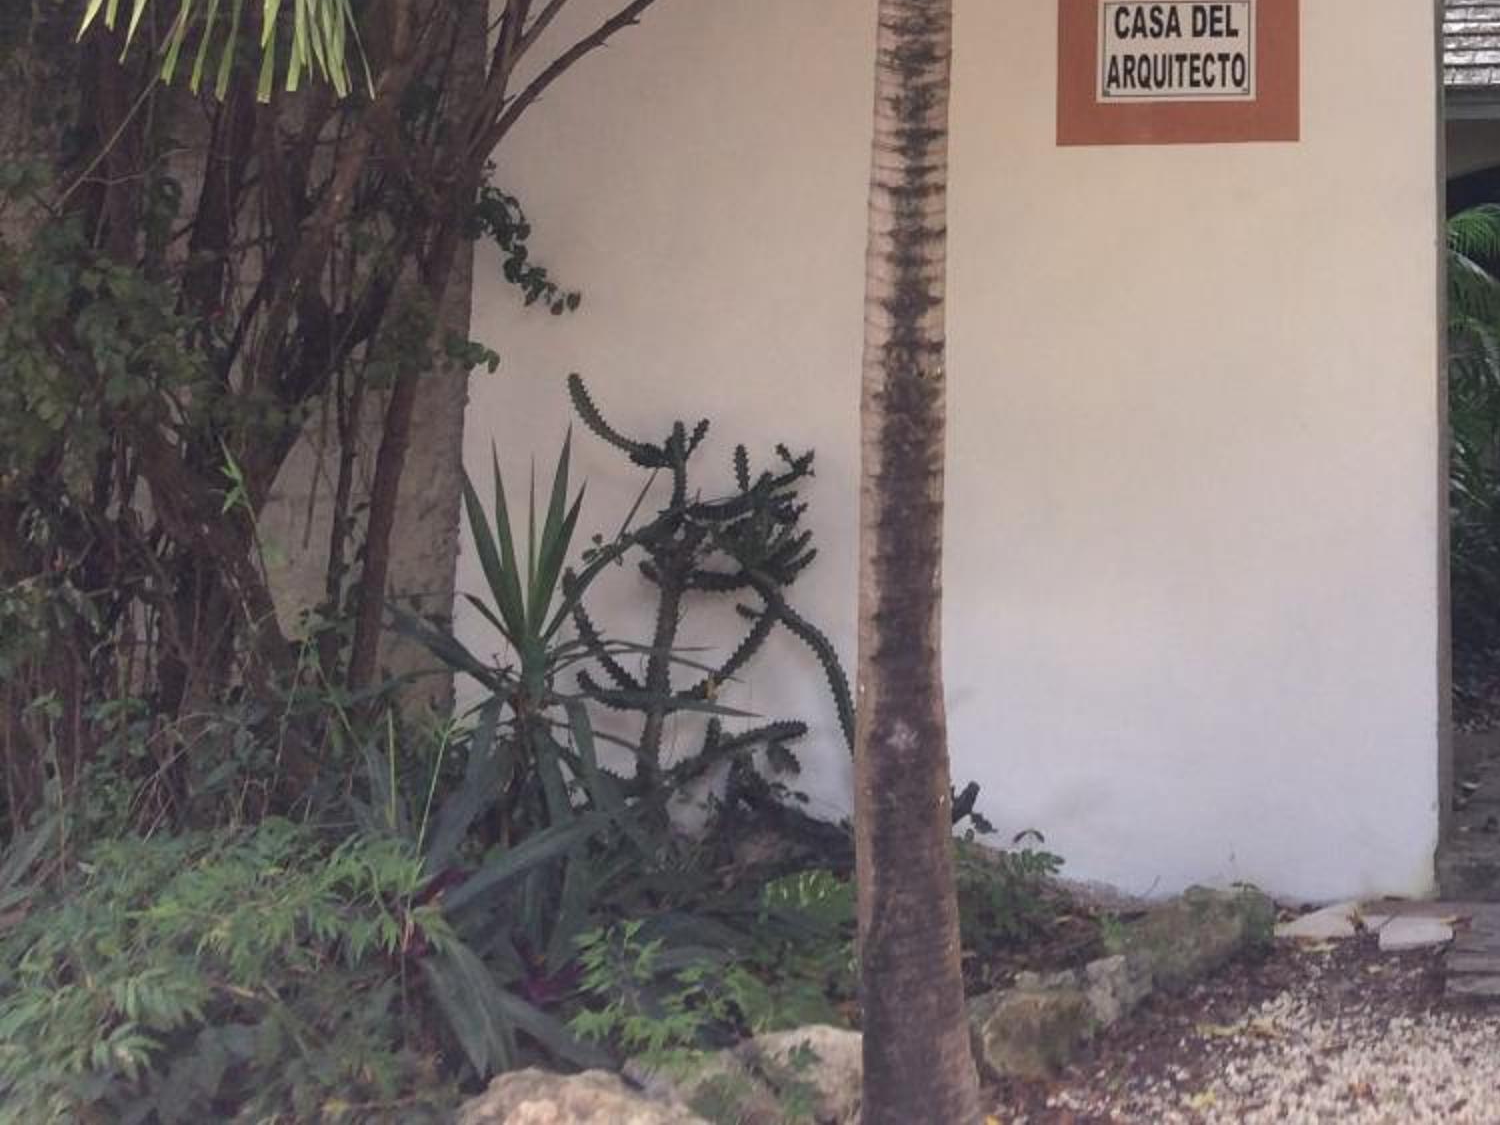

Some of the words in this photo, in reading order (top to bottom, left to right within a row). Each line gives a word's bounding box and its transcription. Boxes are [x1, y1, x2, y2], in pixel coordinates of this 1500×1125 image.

[1115, 5, 1183, 39] CASA
[1192, 4, 1239, 38] DEL
[1107, 52, 1246, 90] ARQUITECTO
